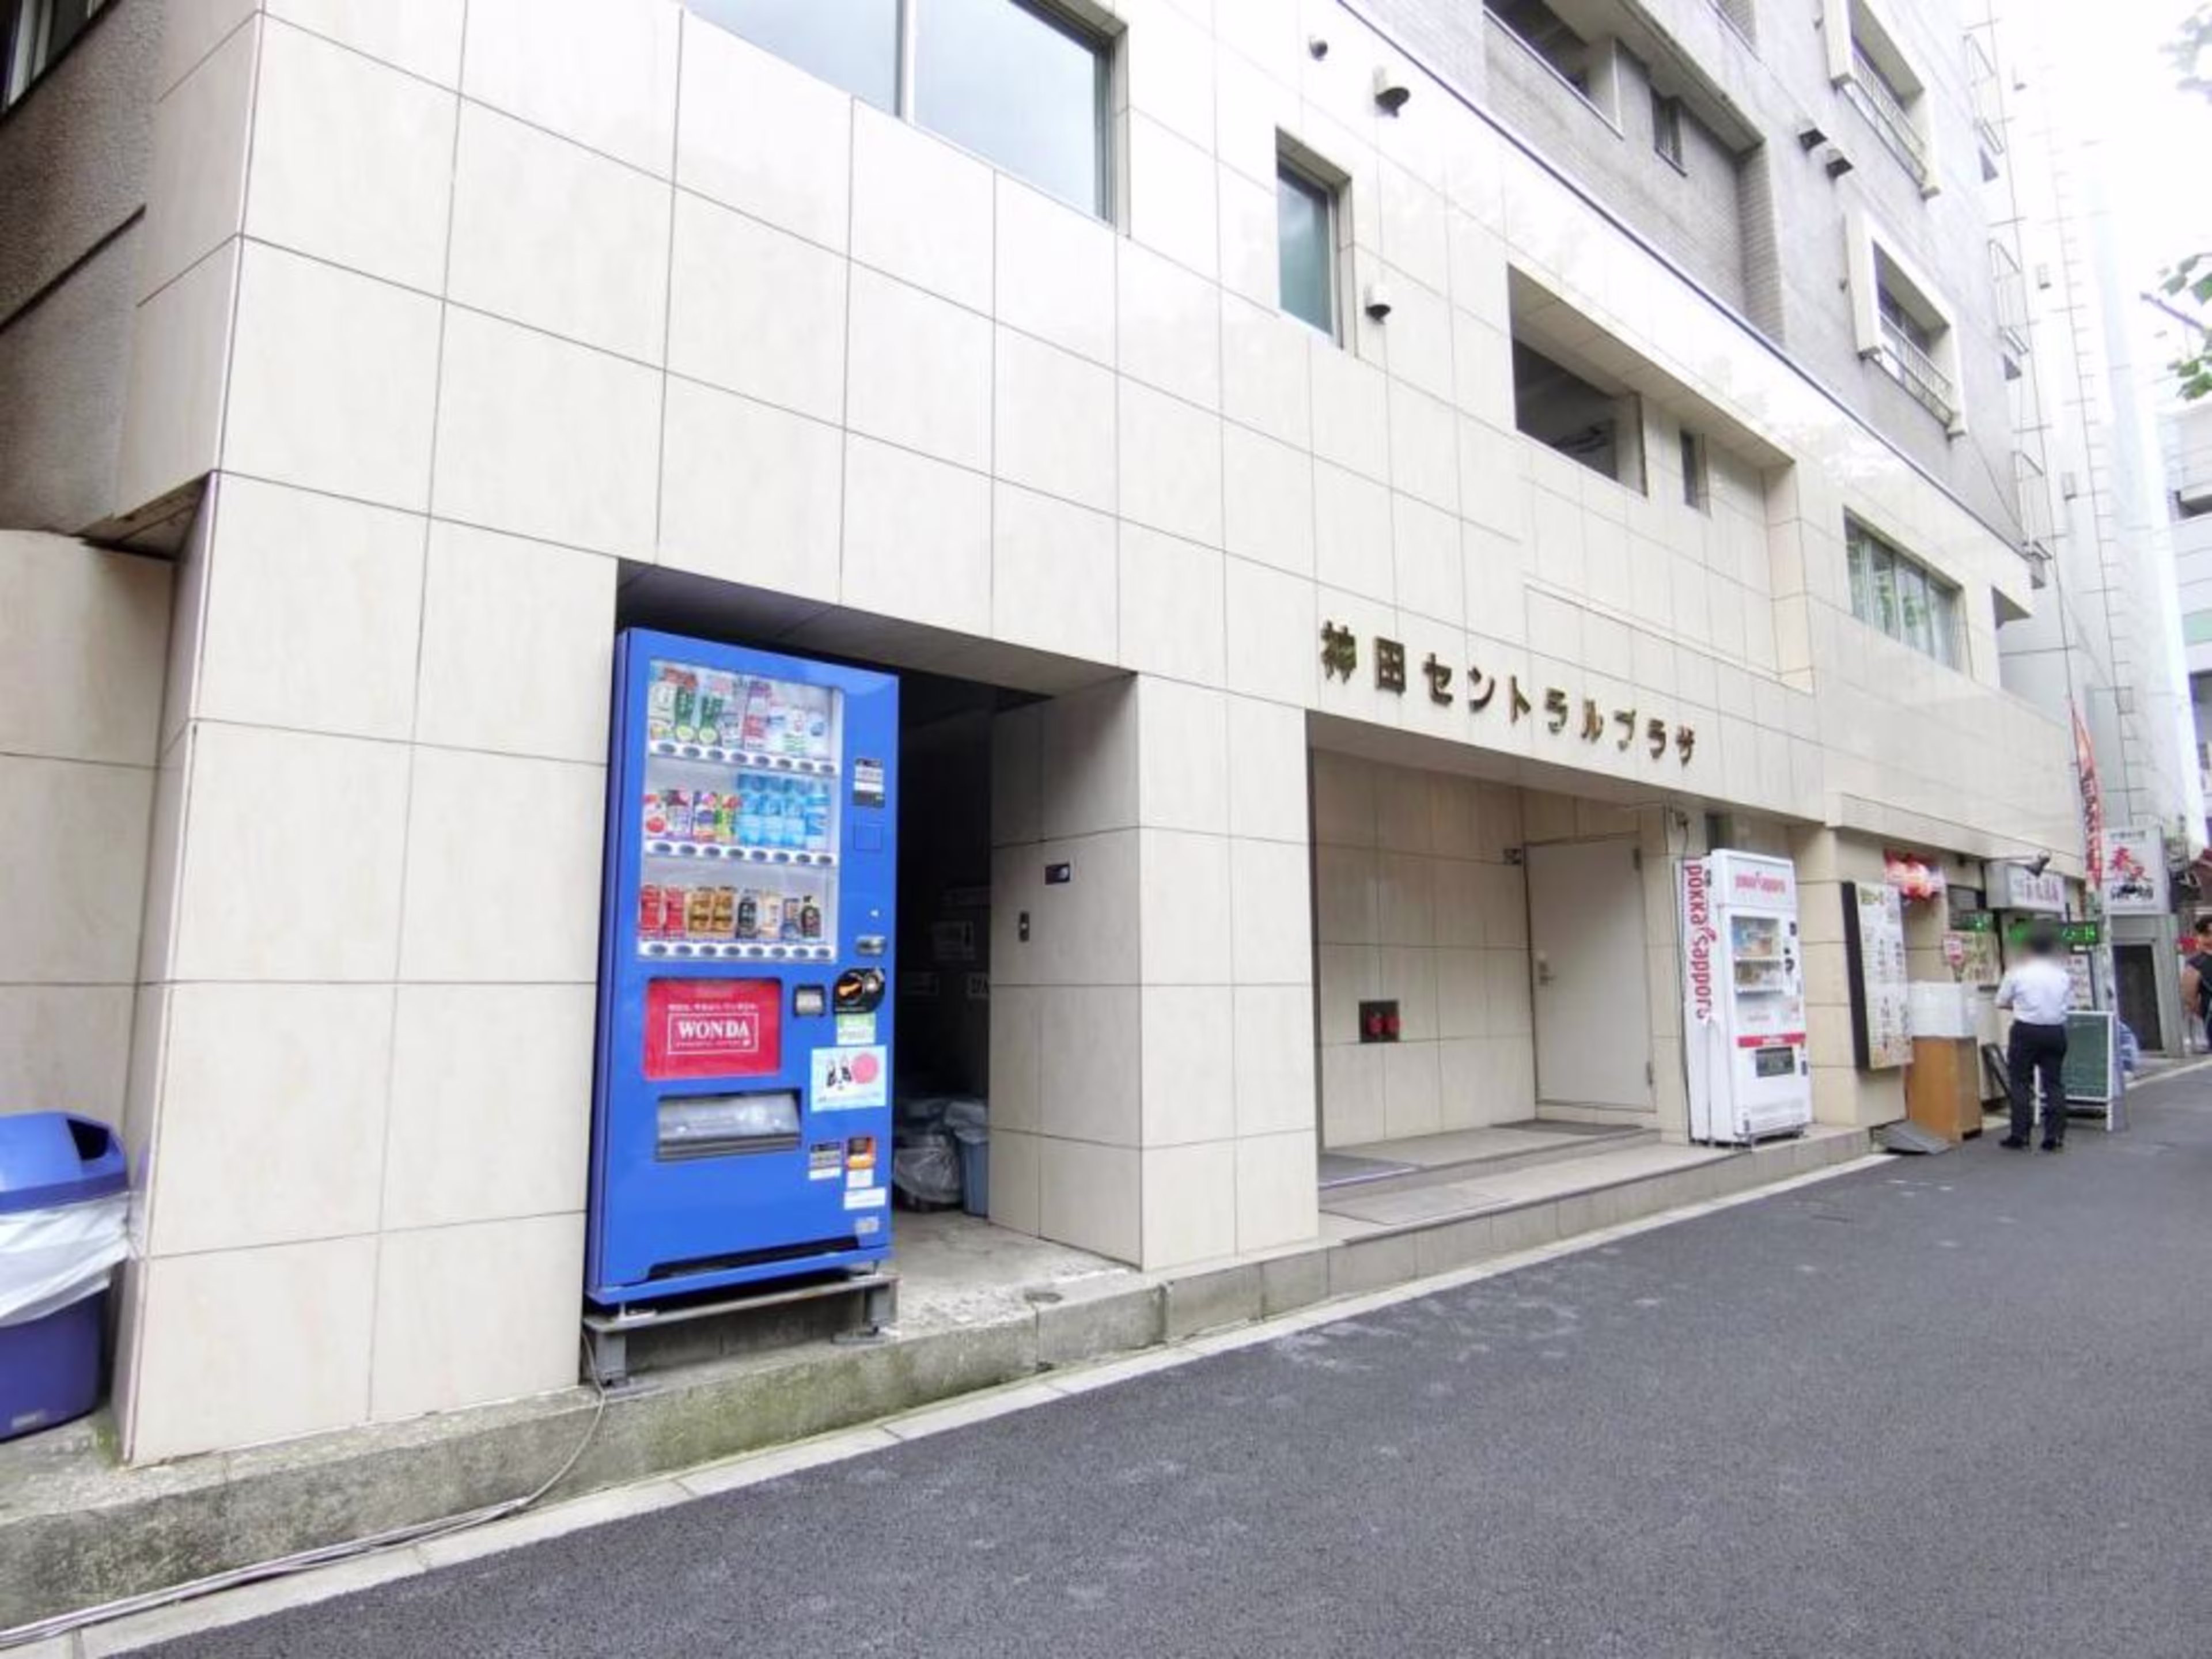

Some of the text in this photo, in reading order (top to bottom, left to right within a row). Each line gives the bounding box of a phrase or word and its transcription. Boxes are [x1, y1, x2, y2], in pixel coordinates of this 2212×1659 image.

[1320, 620, 1696, 766] 神田セントラルプラザ
[677, 1019, 751, 1040] WONDA
